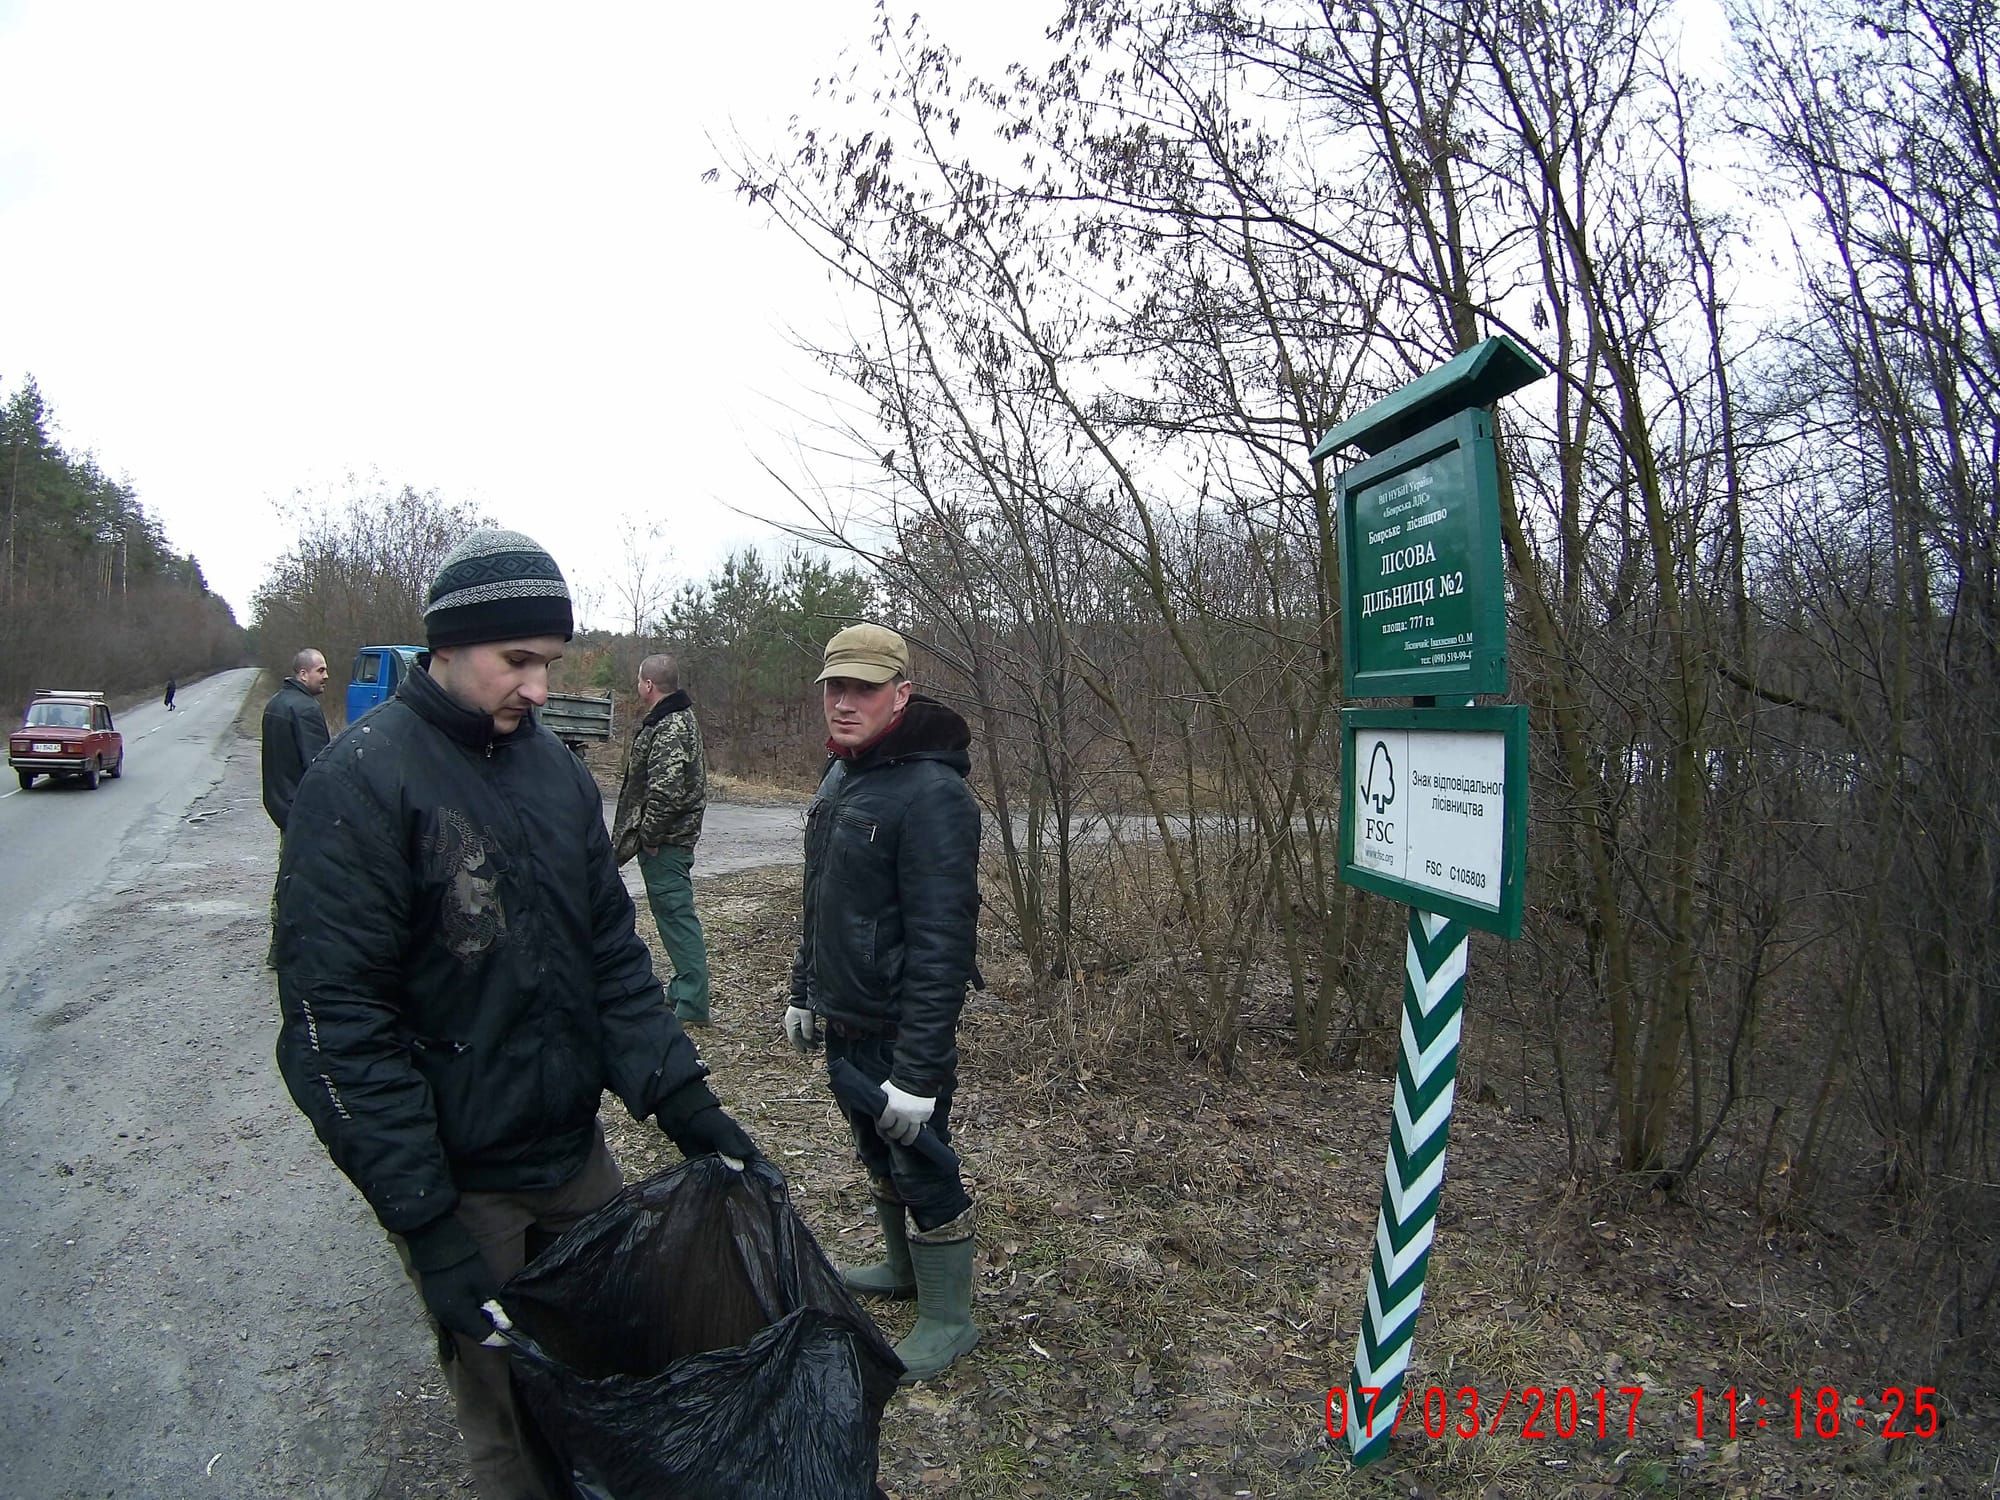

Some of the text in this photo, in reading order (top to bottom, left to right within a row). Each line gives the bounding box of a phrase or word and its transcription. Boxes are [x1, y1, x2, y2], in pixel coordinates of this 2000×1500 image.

[1409, 476, 1434, 492] України
[1368, 508, 1448, 545] Боярське лісництво
[1380, 540, 1437, 576] ЛІСОВА
[1361, 570, 1464, 619] ДІЛЬНИЦЯ №2
[1382, 615, 1435, 635] площа: 777 га
[1412, 770, 1432, 788] Знак
[1431, 793, 1484, 817] лісівництва
[1365, 818, 1395, 844] FSC
[1365, 847, 1394, 865] www.fsc.org
[1425, 860, 1486, 889] FSC C105803
[301, 999, 320, 1053] FLEXFIT
